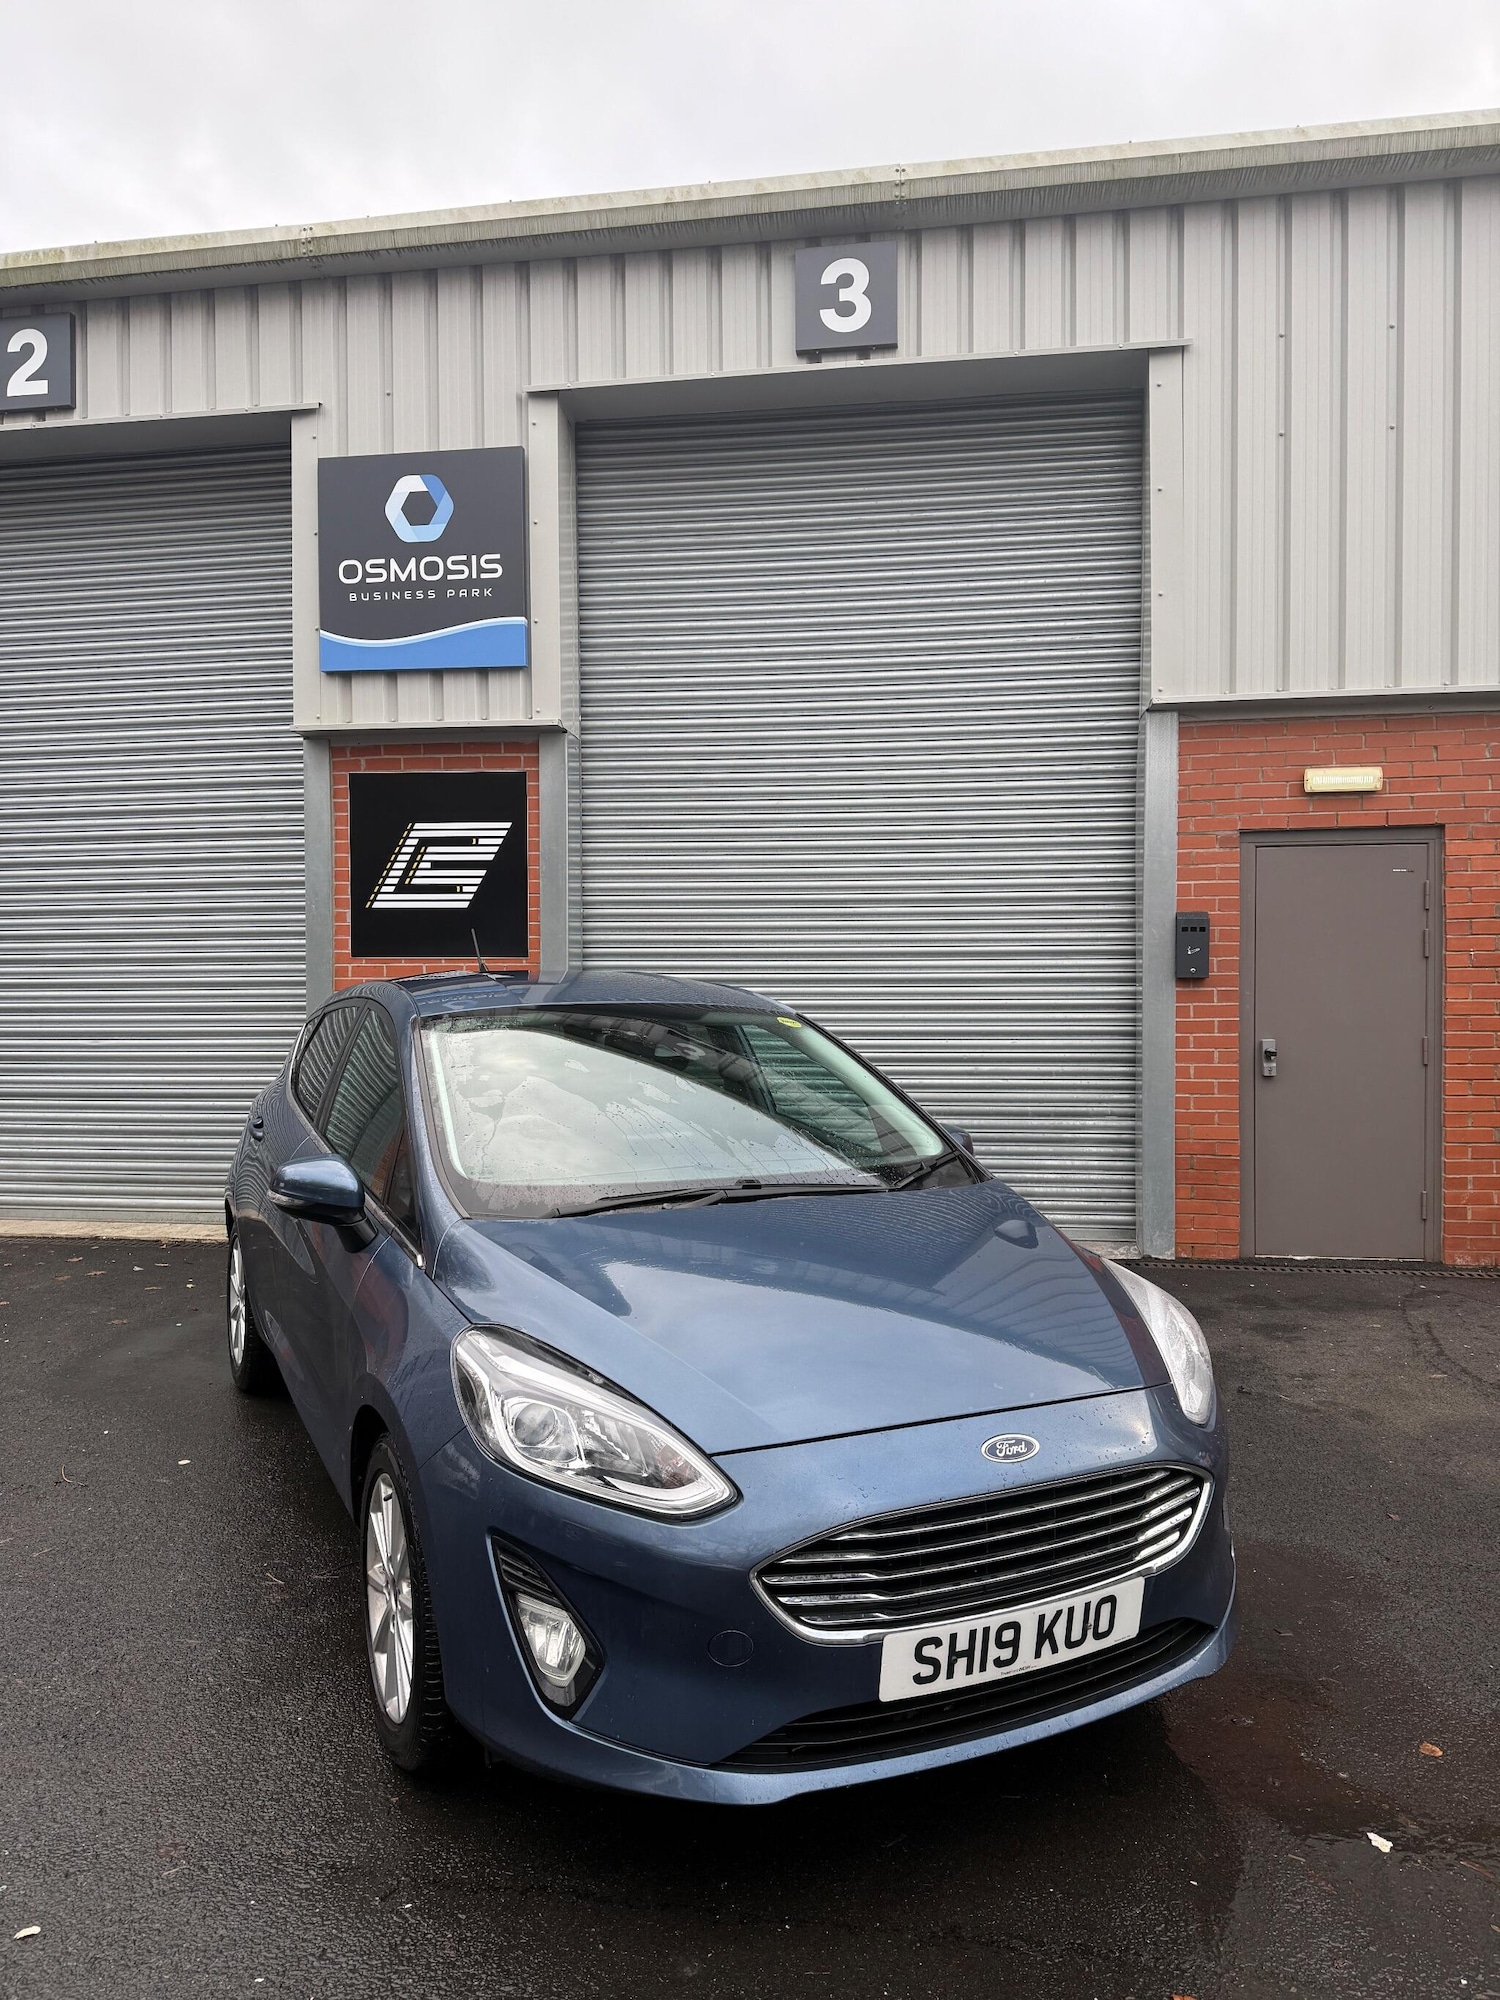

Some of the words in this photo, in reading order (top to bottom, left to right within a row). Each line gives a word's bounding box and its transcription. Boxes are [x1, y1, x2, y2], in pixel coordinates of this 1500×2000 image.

[819, 257, 872, 333] 3
[6, 328, 49, 397] 2
[338, 553, 503, 585] OSMOSIS
[349, 589, 437, 602] BUSINESS
[446, 587, 493, 599] PARK
[996, 1439, 1028, 1457] Ford
[912, 1621, 1022, 1685] SH19
[1034, 1594, 1118, 1660] KUO
